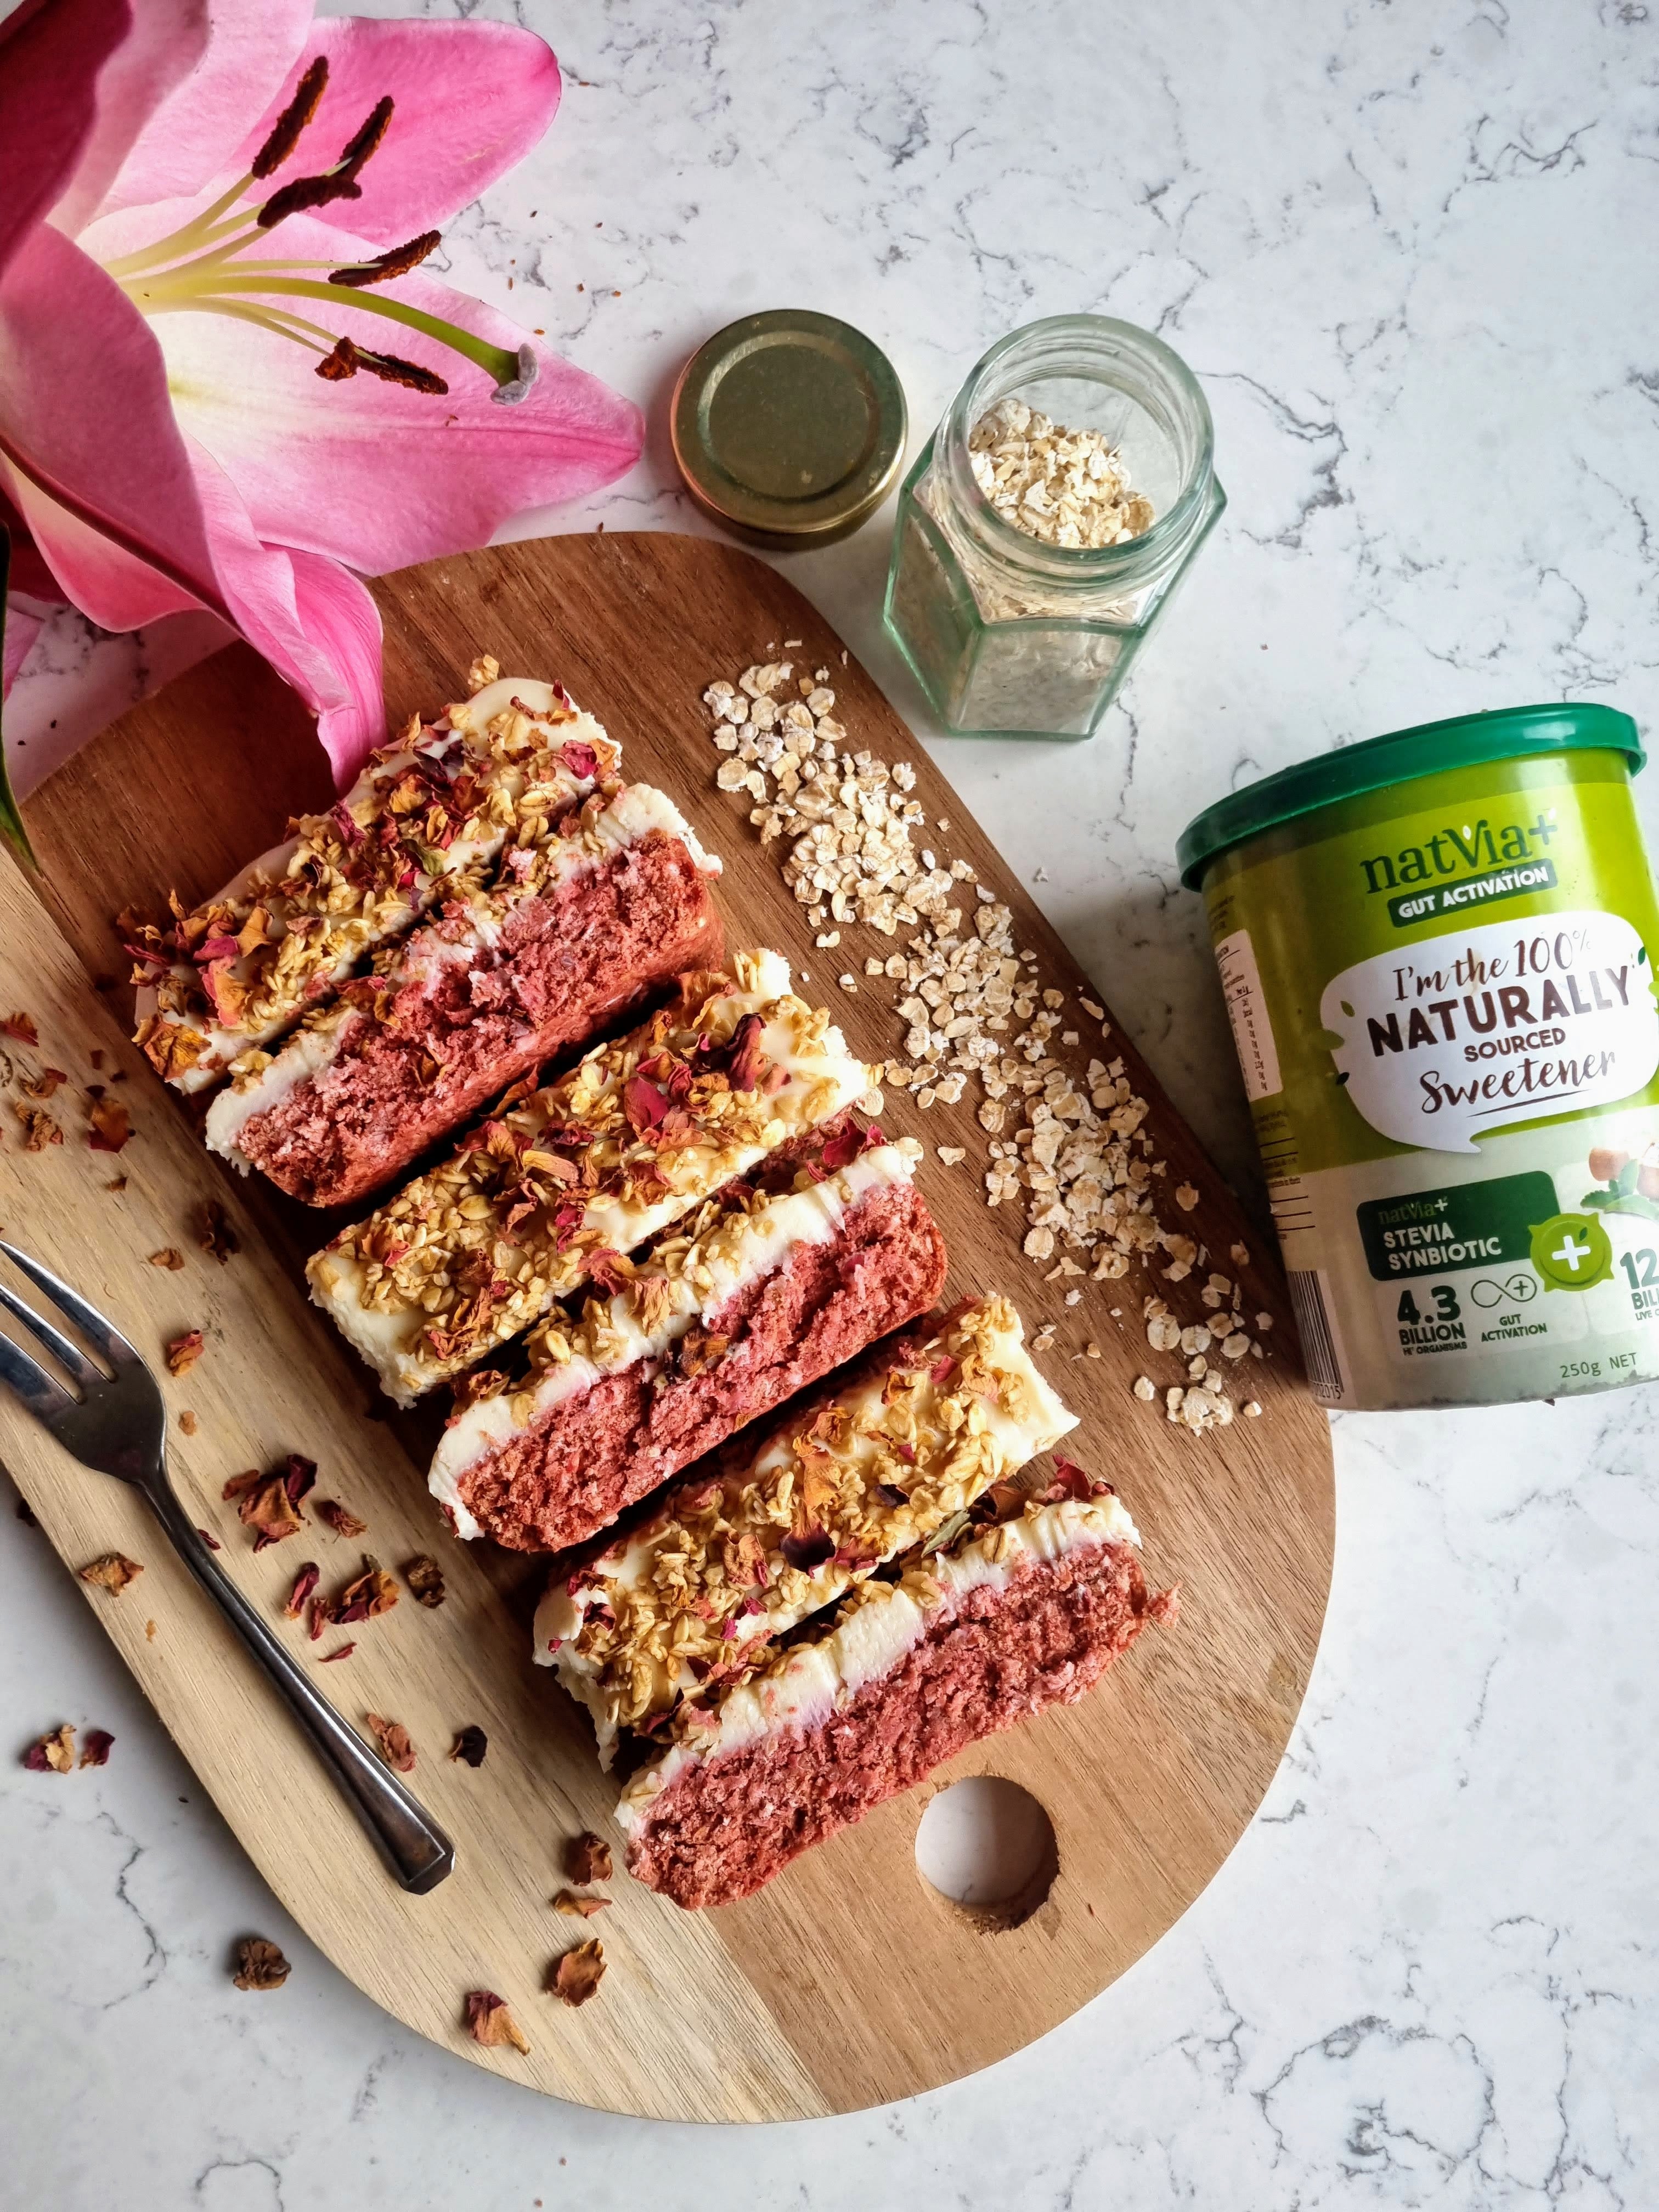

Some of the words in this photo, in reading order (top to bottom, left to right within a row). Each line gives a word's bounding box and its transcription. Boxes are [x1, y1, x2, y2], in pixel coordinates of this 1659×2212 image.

[1398, 895, 1435, 918] GUT
[1443, 866, 1549, 908] ACTIVATION
[1392, 966, 1450, 1001] I'm
[1451, 947, 1509, 986] the
[1514, 928, 1592, 977] 100%
[1367, 965, 1629, 1057] NATURALLY
[1464, 1028, 1566, 1063] SOURCED
[1419, 1051, 1615, 1114] Sweetener
[1383, 1222, 1454, 1249] STEVIA
[1388, 1237, 1502, 1271] SYNBIOTIC
[1397, 1285, 1461, 1325] 4.3
[1635, 1310, 1652, 1321] LIVE
[1399, 1322, 1466, 1346] BILLION
[1481, 1323, 1547, 1342] ACTIVATION
[1499, 1314, 1522, 1327] GUT
[1417, 1341, 1468, 1355] ORGANISMS
[1560, 1361, 1602, 1379] 250g
[1609, 1352, 1637, 1369] NET
